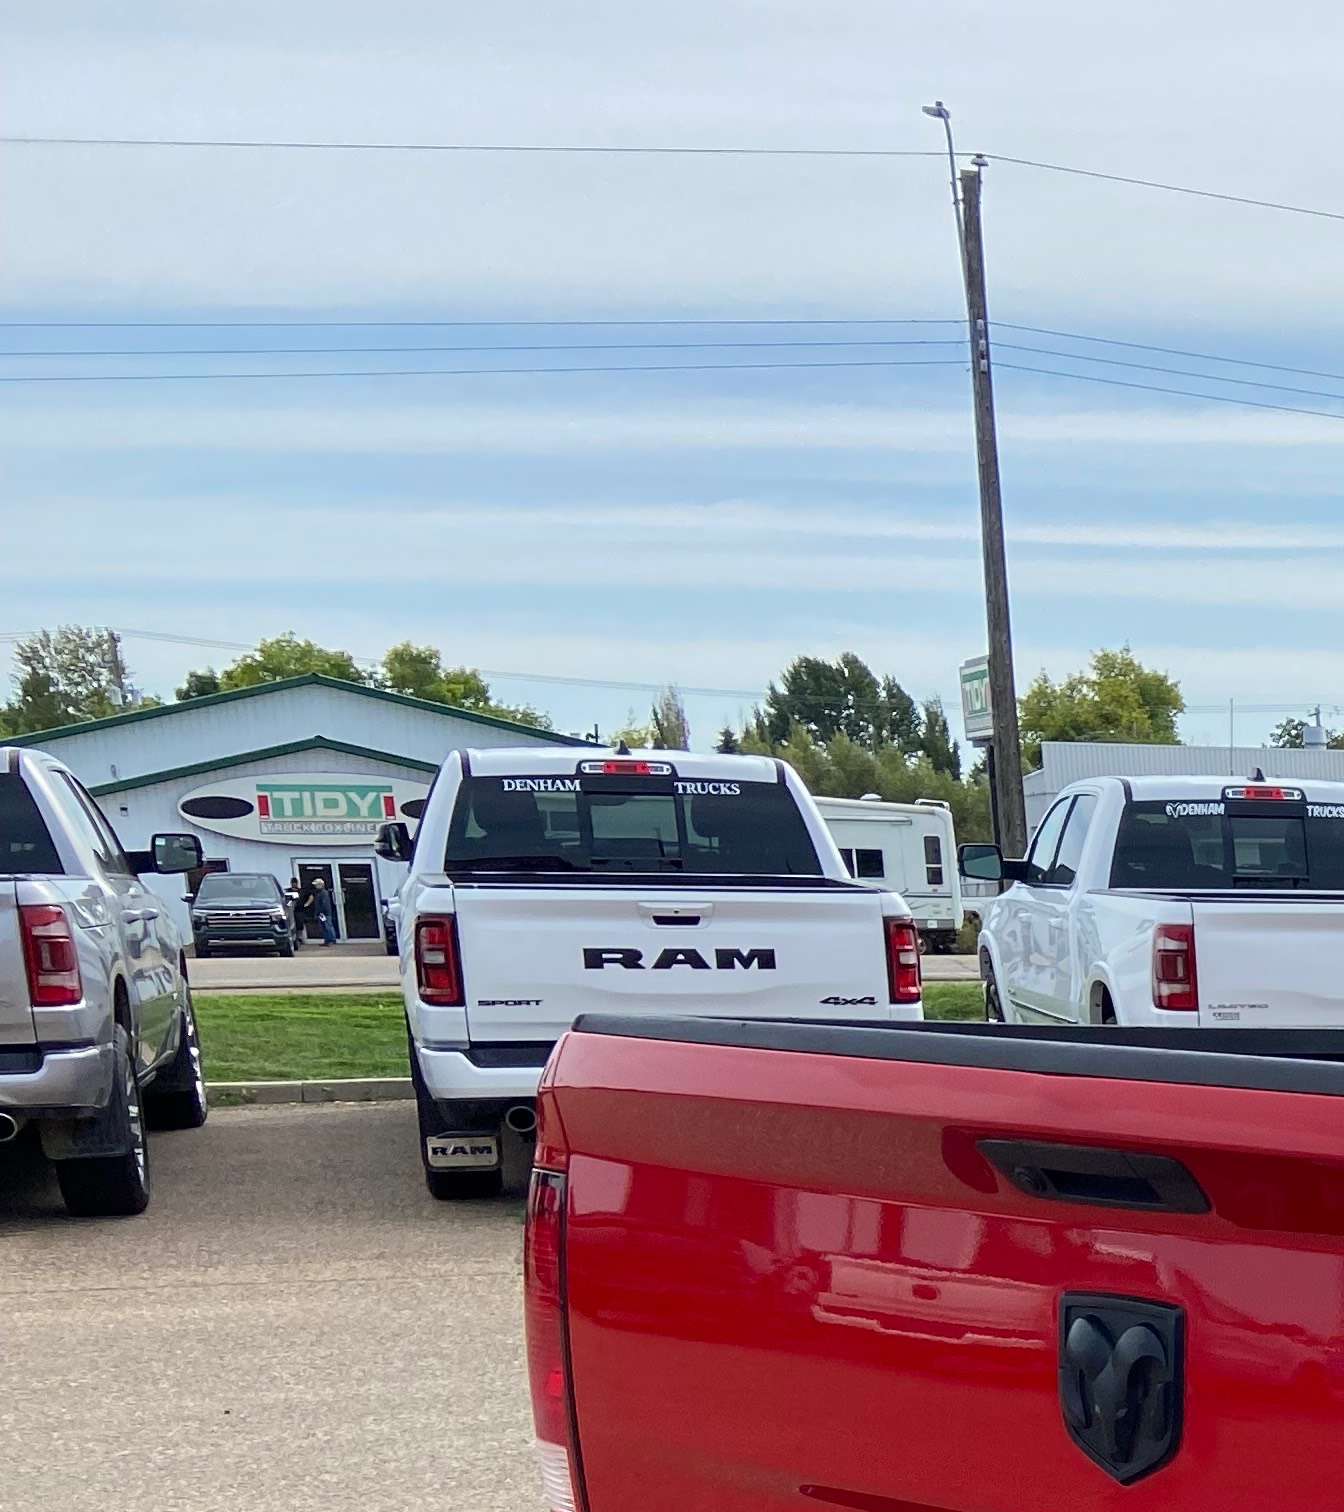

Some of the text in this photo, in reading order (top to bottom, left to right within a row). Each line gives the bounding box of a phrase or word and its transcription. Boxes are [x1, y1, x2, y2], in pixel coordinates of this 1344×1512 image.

[502, 779, 741, 795] DENHAM TRUCKS
[272, 791, 378, 817] TIDY
[1181, 803, 1225, 816] DENHAM
[583, 948, 777, 970] RAM
[477, 999, 544, 1007] SPORT
[431, 1145, 492, 1156] RAM
